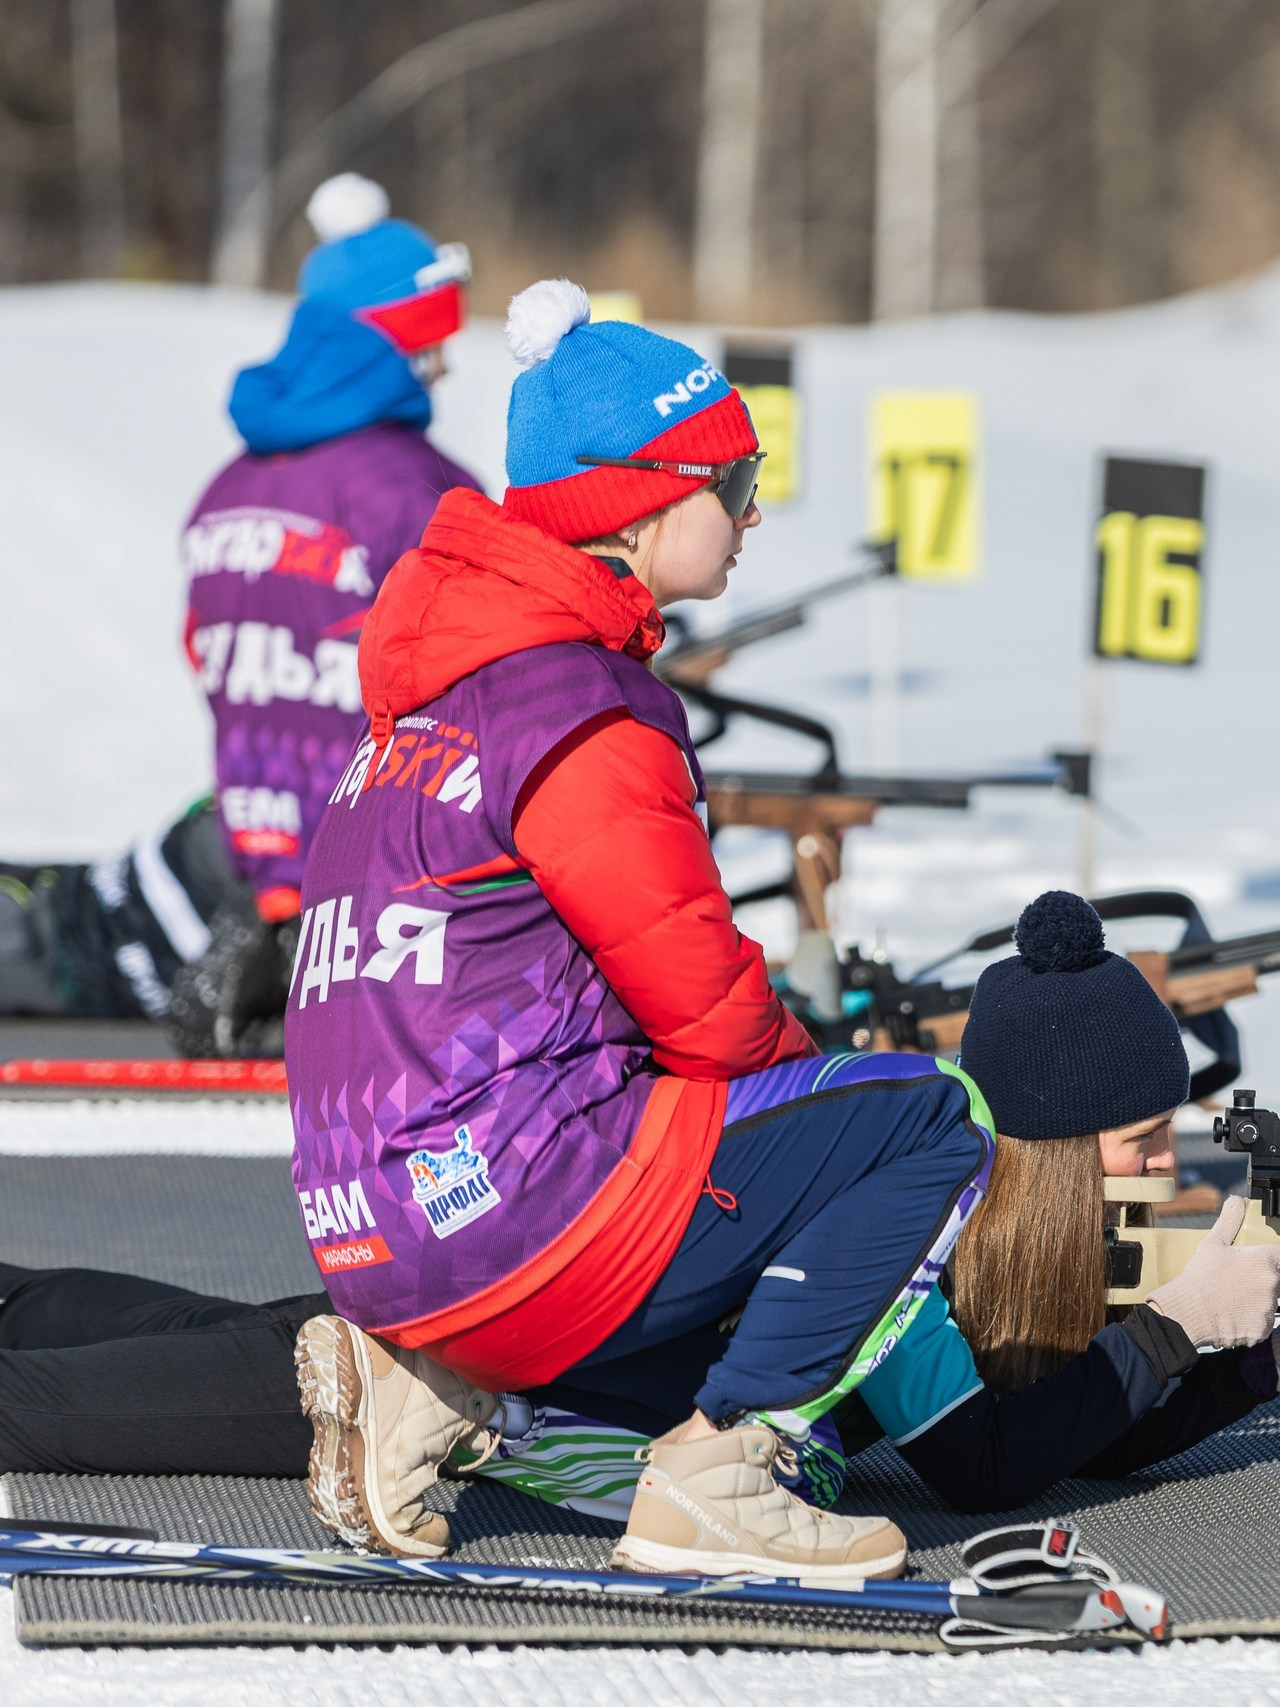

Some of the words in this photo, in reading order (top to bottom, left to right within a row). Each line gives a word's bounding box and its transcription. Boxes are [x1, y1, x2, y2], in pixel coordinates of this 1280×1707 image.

[884, 453, 967, 562] 17
[1098, 510, 1204, 665] 16
[298, 1179, 377, 1240] БАМ
[321, 1243, 375, 1269] МАРАФОНЫ
[665, 1484, 739, 1548] NORTHLAND
